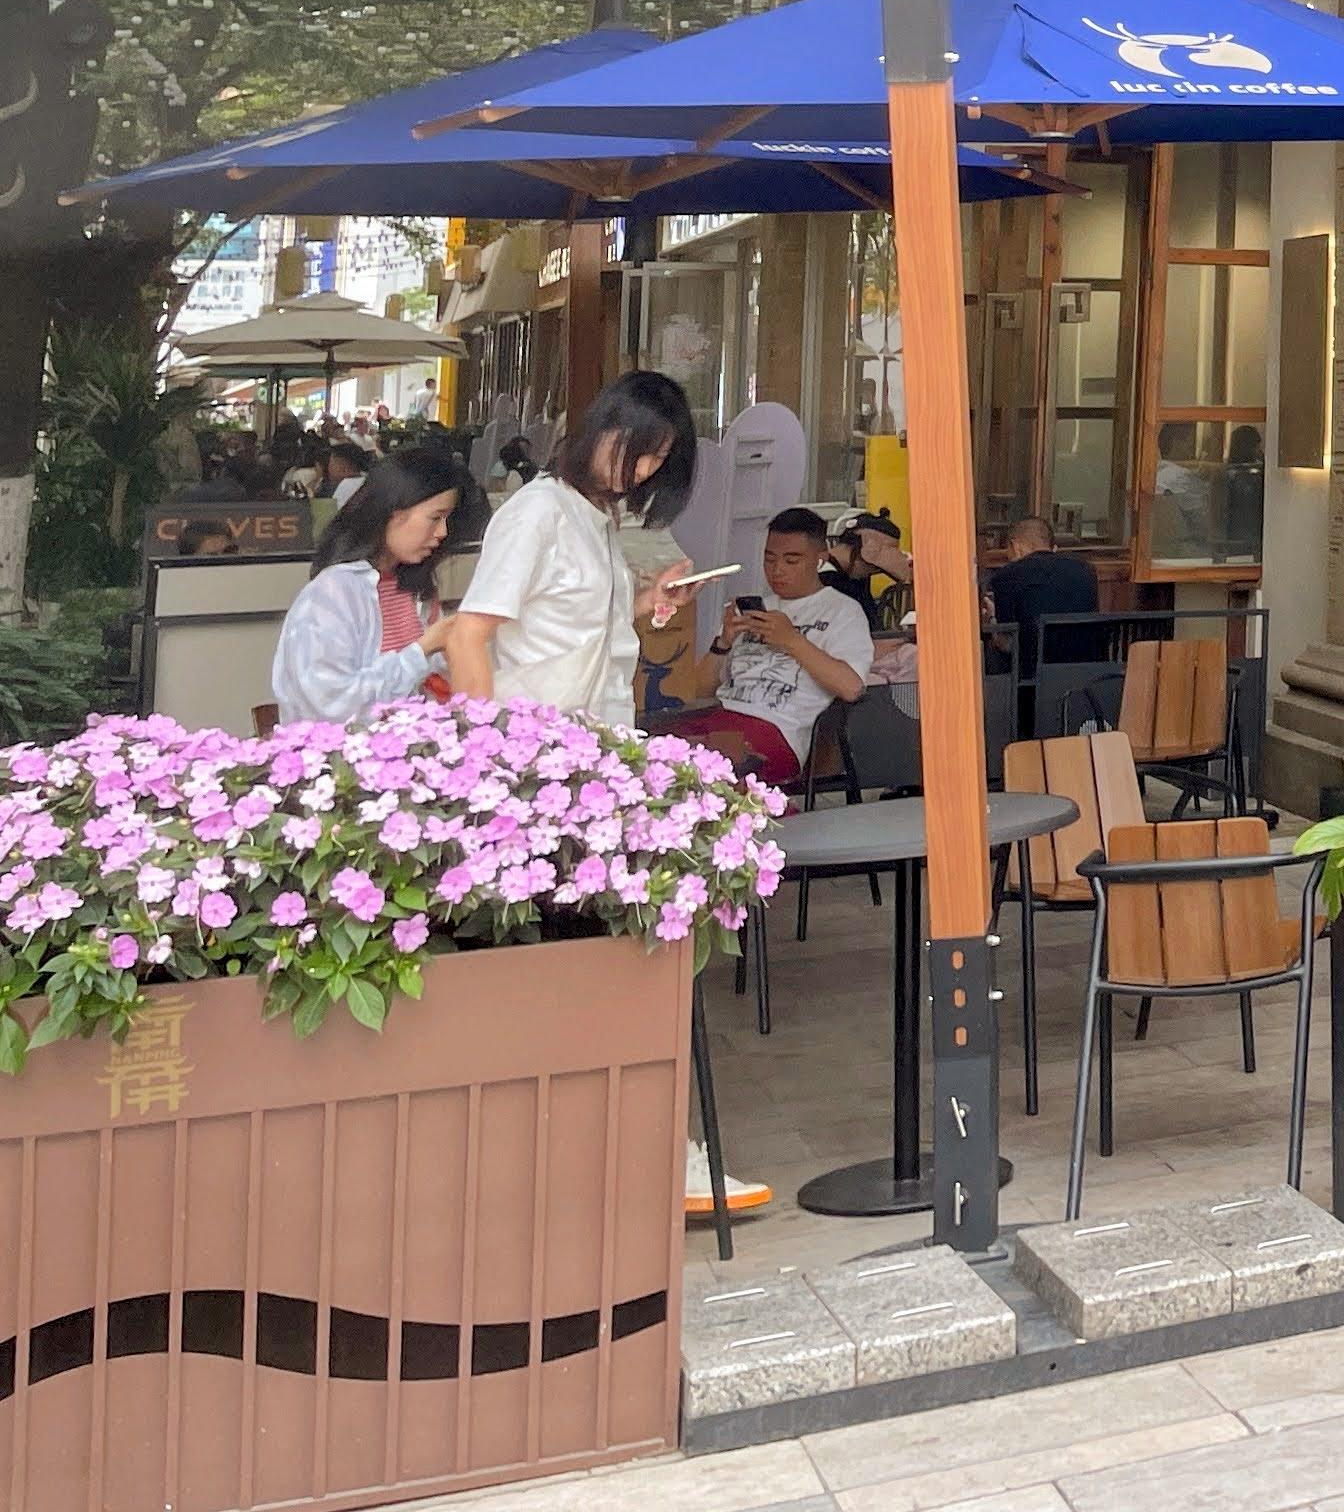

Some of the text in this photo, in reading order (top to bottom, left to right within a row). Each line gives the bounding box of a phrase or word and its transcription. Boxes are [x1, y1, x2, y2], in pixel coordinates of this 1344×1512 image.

[1228, 82, 1339, 96] coffee
[752, 141, 892, 156] luckin coff
[157, 516, 298, 541] CVES
